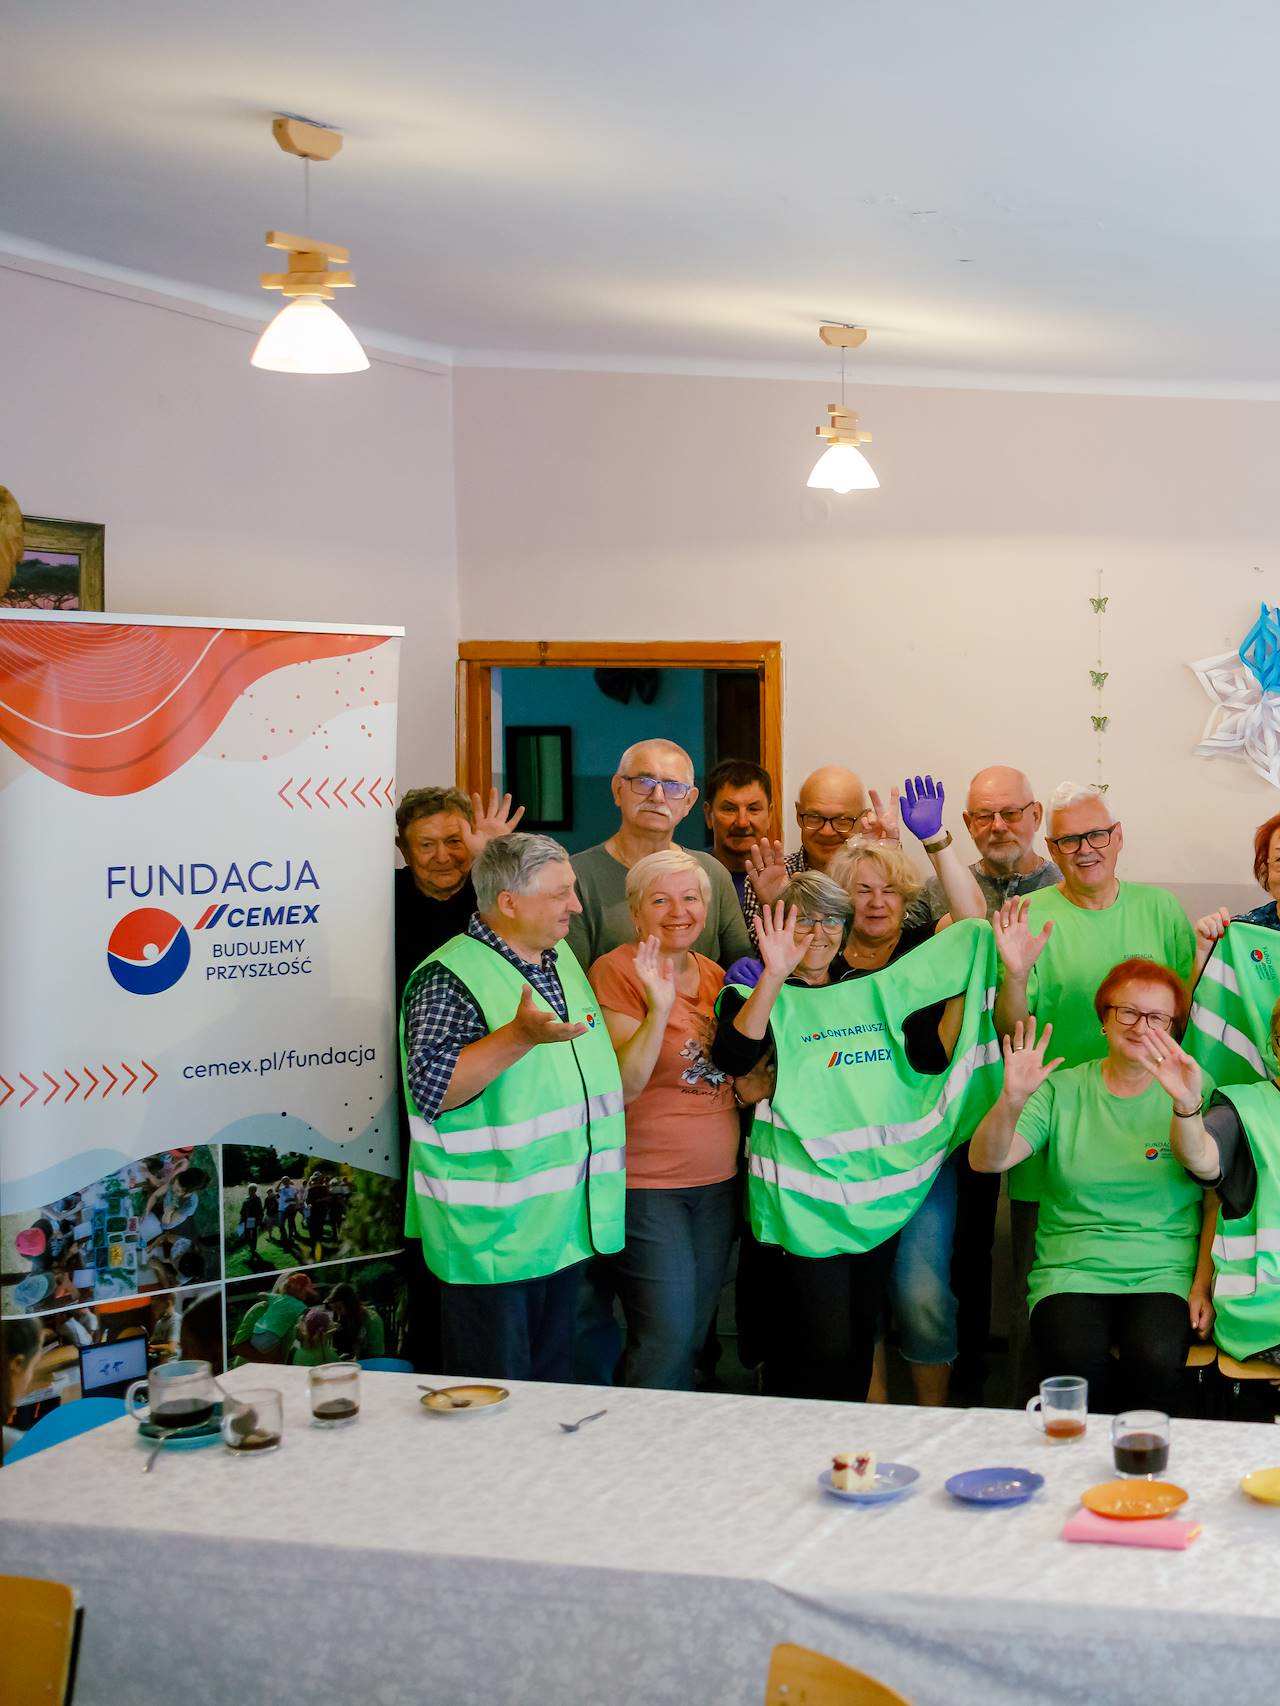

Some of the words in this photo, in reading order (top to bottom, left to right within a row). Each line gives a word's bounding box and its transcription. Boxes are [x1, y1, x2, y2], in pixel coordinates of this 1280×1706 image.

[107, 860, 320, 899] FUNDACJA
[227, 904, 320, 928] CEMEX
[213, 939, 305, 958] BUDUJEMY
[206, 956, 312, 980] PRZYSZŁOŚĆ
[183, 1045, 376, 1079] cemex.pl/fundacja
[843, 1048, 892, 1065] CEMEX
